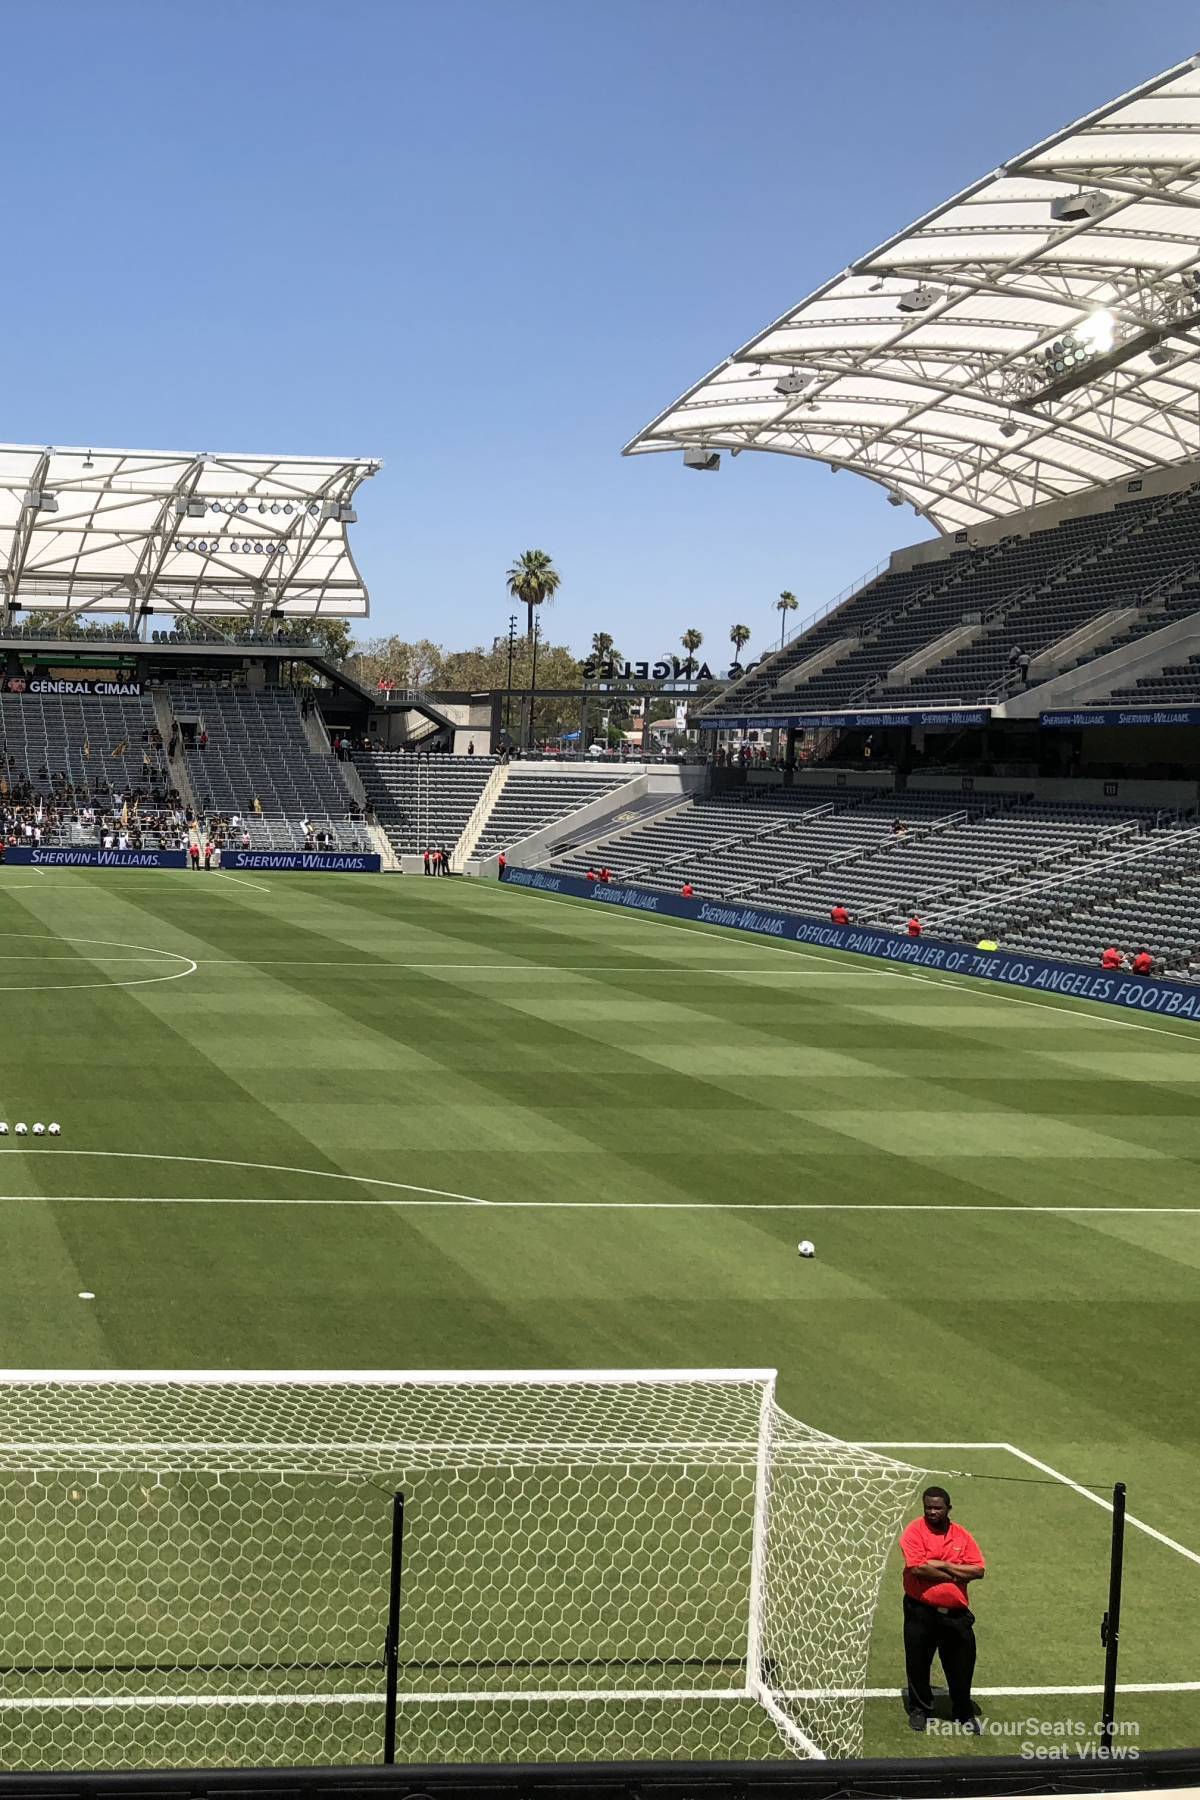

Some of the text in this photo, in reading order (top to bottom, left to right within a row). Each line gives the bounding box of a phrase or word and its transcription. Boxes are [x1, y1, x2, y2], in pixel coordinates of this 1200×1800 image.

[30, 680, 140, 695] GÉNÉRAL CIMAN
[921, 713, 982, 725] SHERWIN-WILLIAMS
[1042, 714, 1105, 726] SHERWIN-WILLIAMS
[1118, 712, 1190, 724] SHERWIN-WILLIAMS
[30, 850, 160, 866] SHERWIN-WILLIAMS
[236, 853, 365, 869] SHERWIN-WILLIAMS
[506, 868, 560, 890] SHERWIN-WILLIAMS
[590, 883, 659, 910] SHERWIN-WILLIAMS
[697, 903, 785, 934] SHERWIN-WILLIAMS
[796, 924, 842, 947] OFFICIAL
[846, 933, 885, 954] PAINT
[882, 940, 945, 968] SUPPLIER
[945, 952, 970, 972] OF
[968, 955, 1000, 977] THE
[998, 961, 1034, 983] LOS
[1033, 968, 1114, 999] ANGELES
